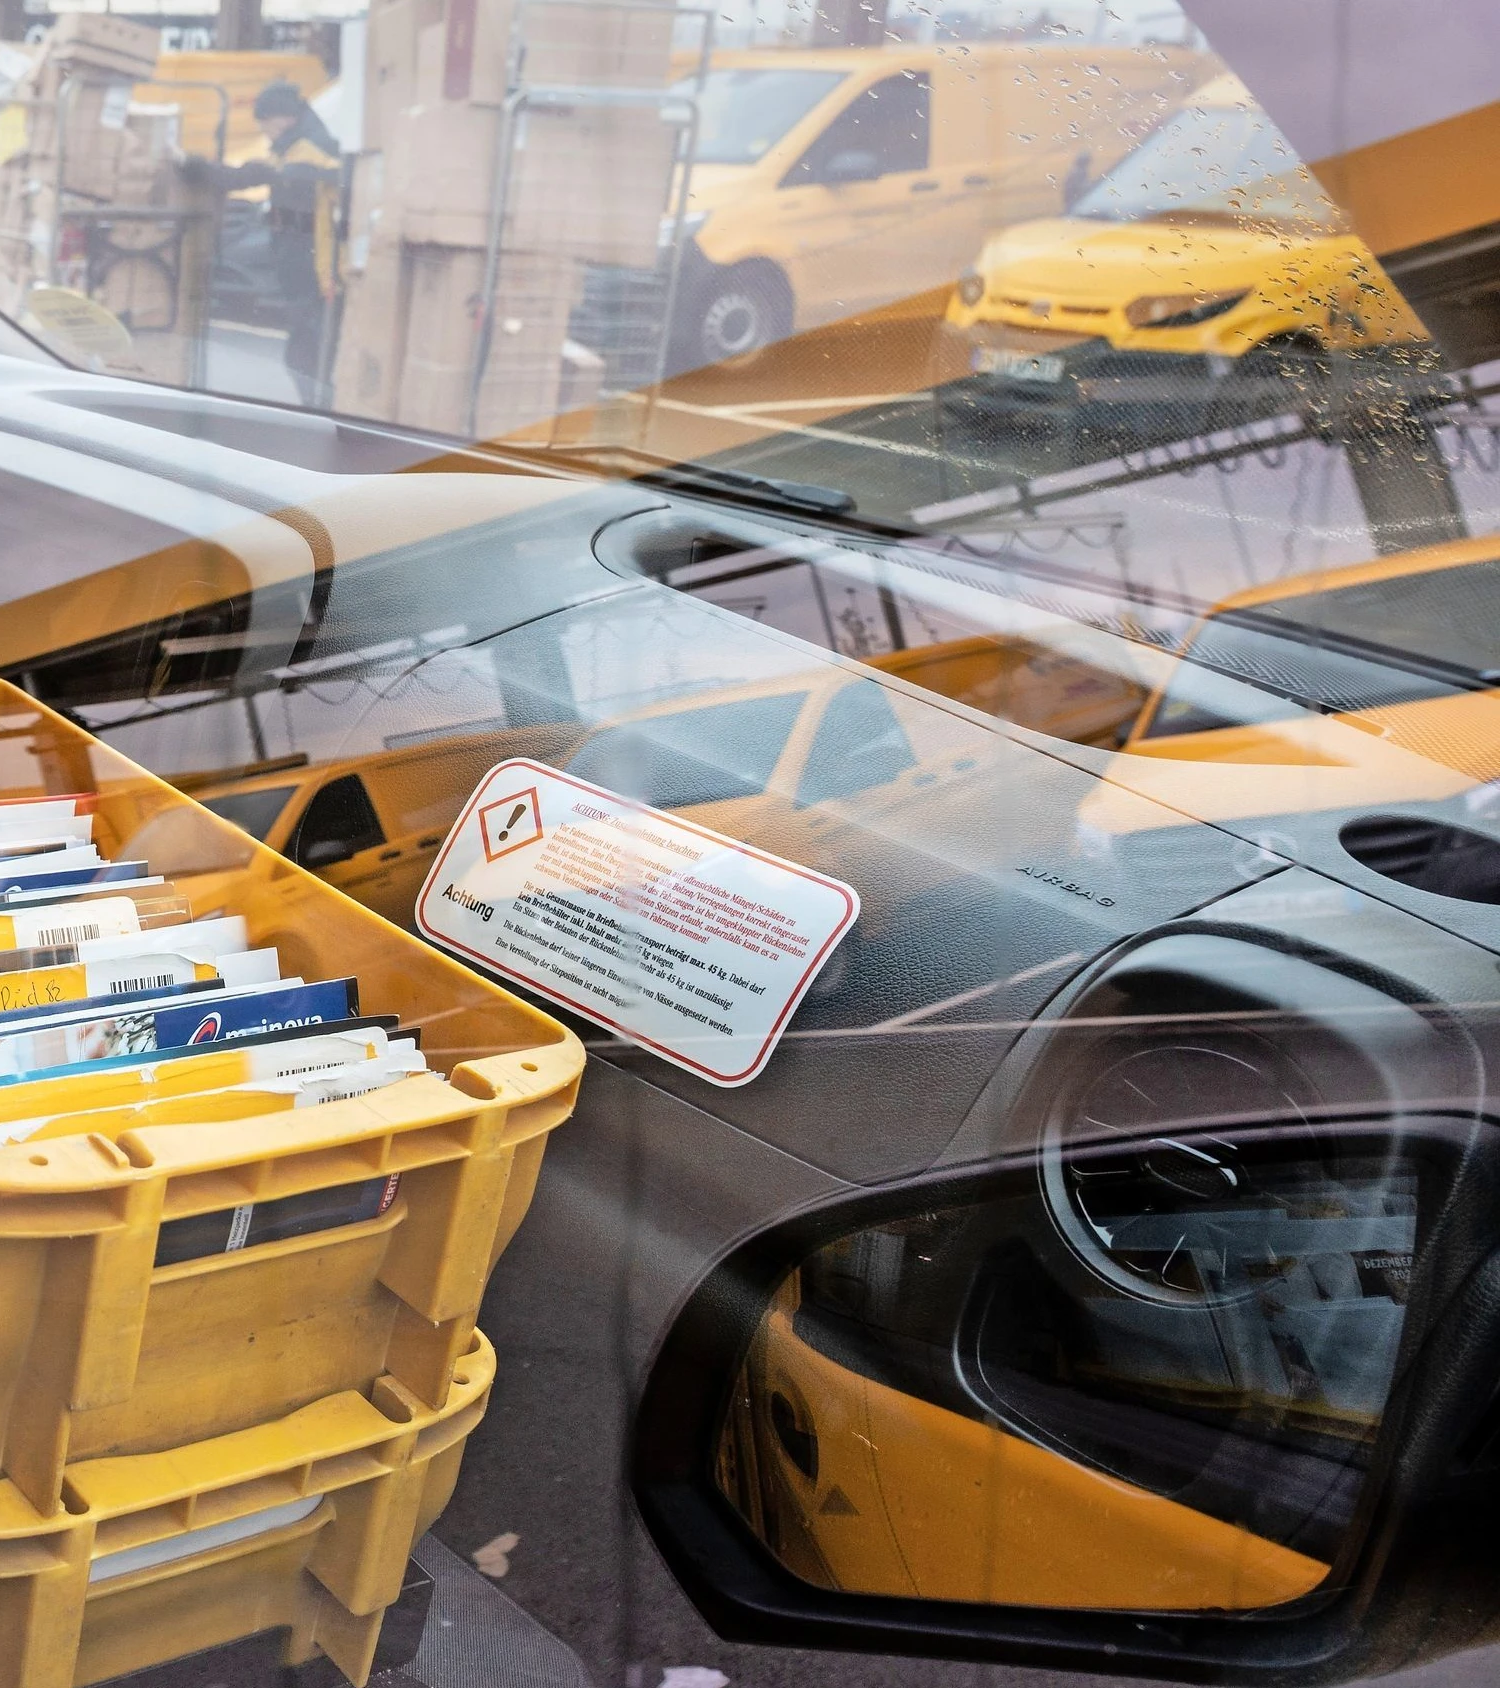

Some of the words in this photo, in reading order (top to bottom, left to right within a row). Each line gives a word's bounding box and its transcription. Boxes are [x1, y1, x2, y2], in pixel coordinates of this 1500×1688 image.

[573, 801, 612, 823] ACHTUNG:
[442, 883, 495, 922] Achtung
[598, 889, 614, 902] oder
[638, 909, 649, 918] am
[648, 912, 680, 932] Fahrzeug
[677, 924, 710, 944] kommen!
[601, 878, 615, 890] und
[654, 901, 680, 918] Stützen
[677, 912, 705, 930] erlaubt,
[703, 922, 743, 945] andernfalls
[741, 939, 761, 953] kann
[759, 949, 769, 957] es
[768, 953, 779, 961] zu
[644, 870, 660, 883] dass
[670, 882, 746, 920] Bolzen/Verriegelungen
[744, 913, 771, 930] korrekt
[769, 923, 810, 947] eingerastet
[646, 885, 659, 896] des
[657, 890, 696, 913] Fahrzeuges
[694, 905, 705, 915] ist
[703, 909, 716, 920] bei
[714, 914, 763, 941] umgeklappter
[761, 933, 807, 959] Rückenlehne
[682, 874, 730, 899] offensichtliche
[728, 893, 786, 924] Mängel/Schäden
[785, 918, 795, 927] zu
[1015, 867, 1115, 907] AIRBAG
[494, 937, 509, 949] Eine
[506, 943, 541, 966] Verstellung
[538, 958, 551, 969] der
[547, 963, 585, 987] Sitzposition
[582, 979, 593, 990] ist
[591, 983, 609, 997] nicht
[511, 901, 524, 912] Ein
[522, 906, 541, 920] Sitzen
[539, 914, 555, 927] oder
[553, 920, 579, 938] Belasten
[577, 932, 590, 943] der
[638, 960, 657, 974] mehr
[655, 967, 667, 979] als
[665, 972, 677, 983] 45
[674, 977, 686, 989] kg
[684, 981, 696, 992] ist
[693, 985, 734, 1011] unzulässig!
[517, 891, 532, 903] kein
[530, 897, 571, 921] Briefbehälter
[569, 915, 586, 928] inkl.
[584, 922, 606, 937] Inhalt
[604, 931, 622, 945] mehr
[640, 948, 652, 960] kg
[649, 952, 676, 971] wiegen.
[545, 890, 587, 915] Gesamtmasse
[585, 908, 597, 919] im
[663, 944, 691, 964] beträgt
[688, 957, 707, 970] max.
[706, 963, 718, 974] 45
[715, 968, 730, 981] kg.
[728, 973, 750, 988] Dabei
[748, 982, 766, 996] darf
[502, 920, 514, 931] Die
[512, 925, 550, 948] Rückenlehne
[547, 941, 563, 954] darf
[560, 947, 581, 962] keiner
[578, 956, 608, 977] längeren
[641, 987, 654, 998] von
[653, 991, 675, 1007] Nässe
[672, 1000, 709, 1025] ausgesetzt
[707, 1017, 736, 1036] werden.
